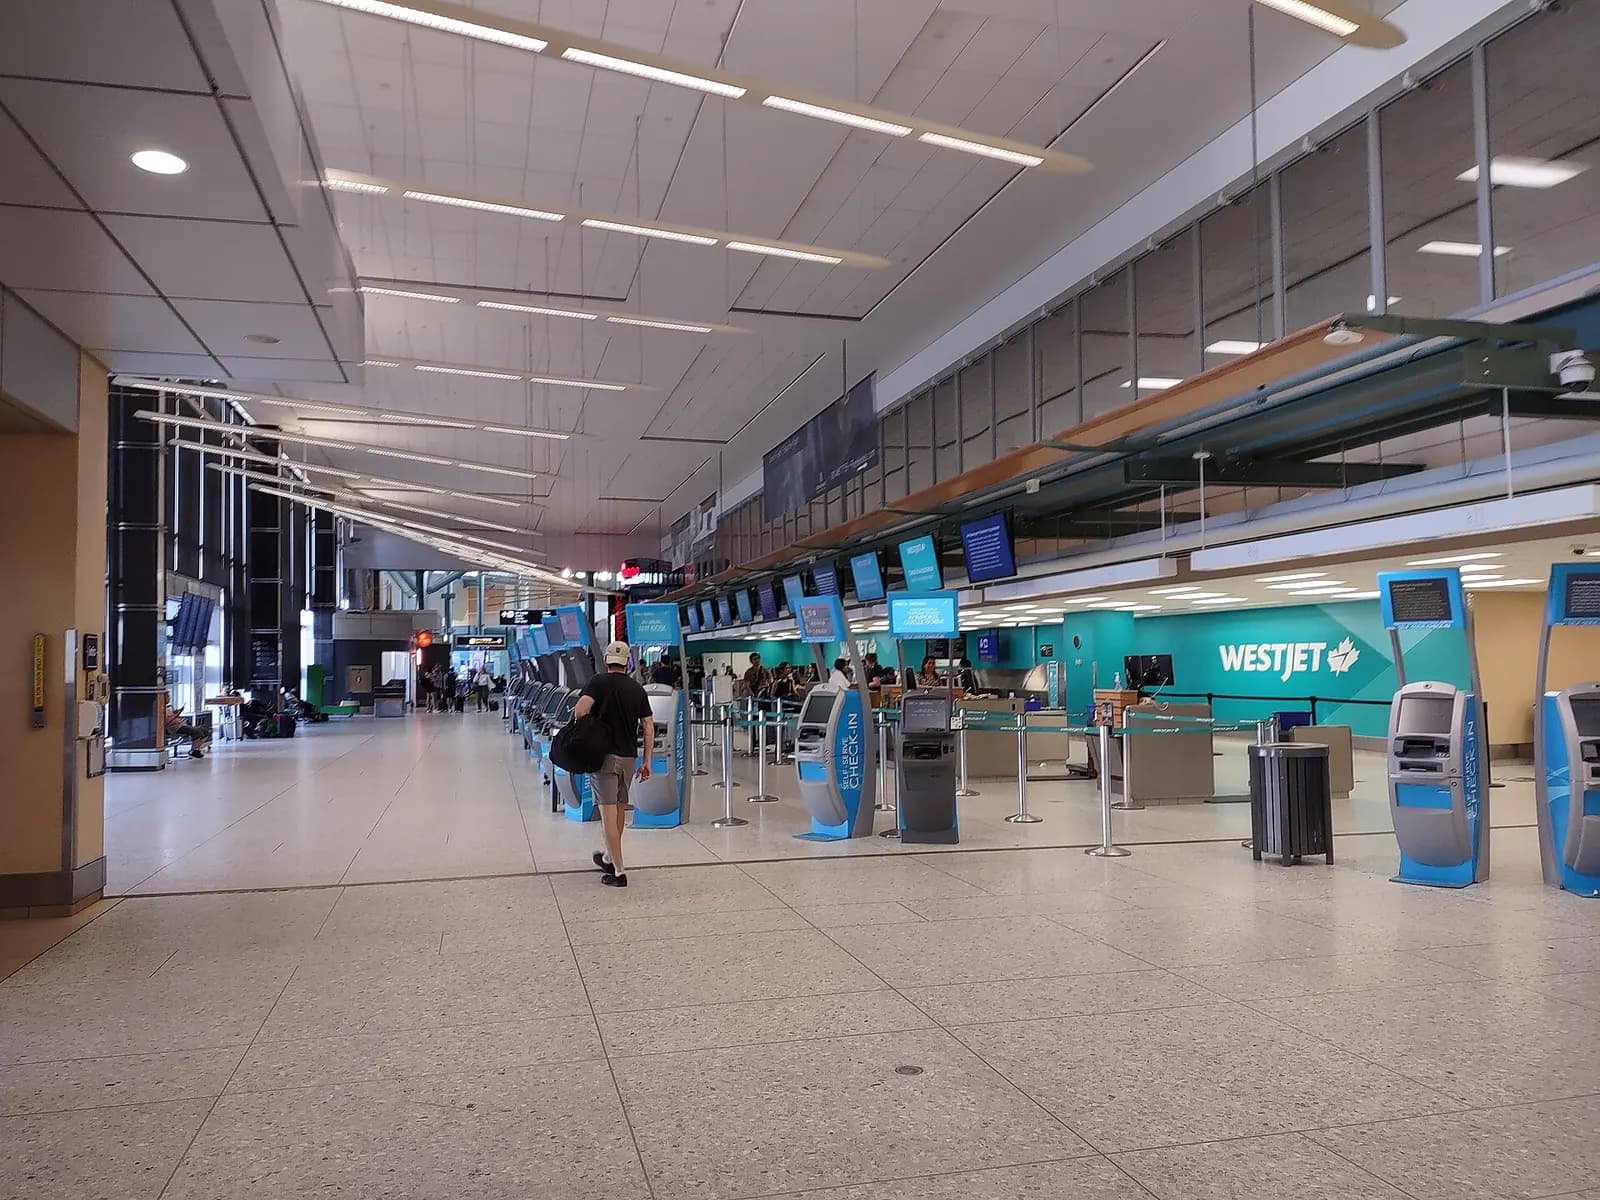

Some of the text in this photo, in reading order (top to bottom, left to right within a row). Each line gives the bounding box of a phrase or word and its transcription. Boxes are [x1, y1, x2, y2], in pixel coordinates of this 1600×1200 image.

[1218, 642, 1327, 683] WESTJET
[848, 713, 860, 789] CHECK-IN
[1468, 721, 1478, 818] CHECK-IN
